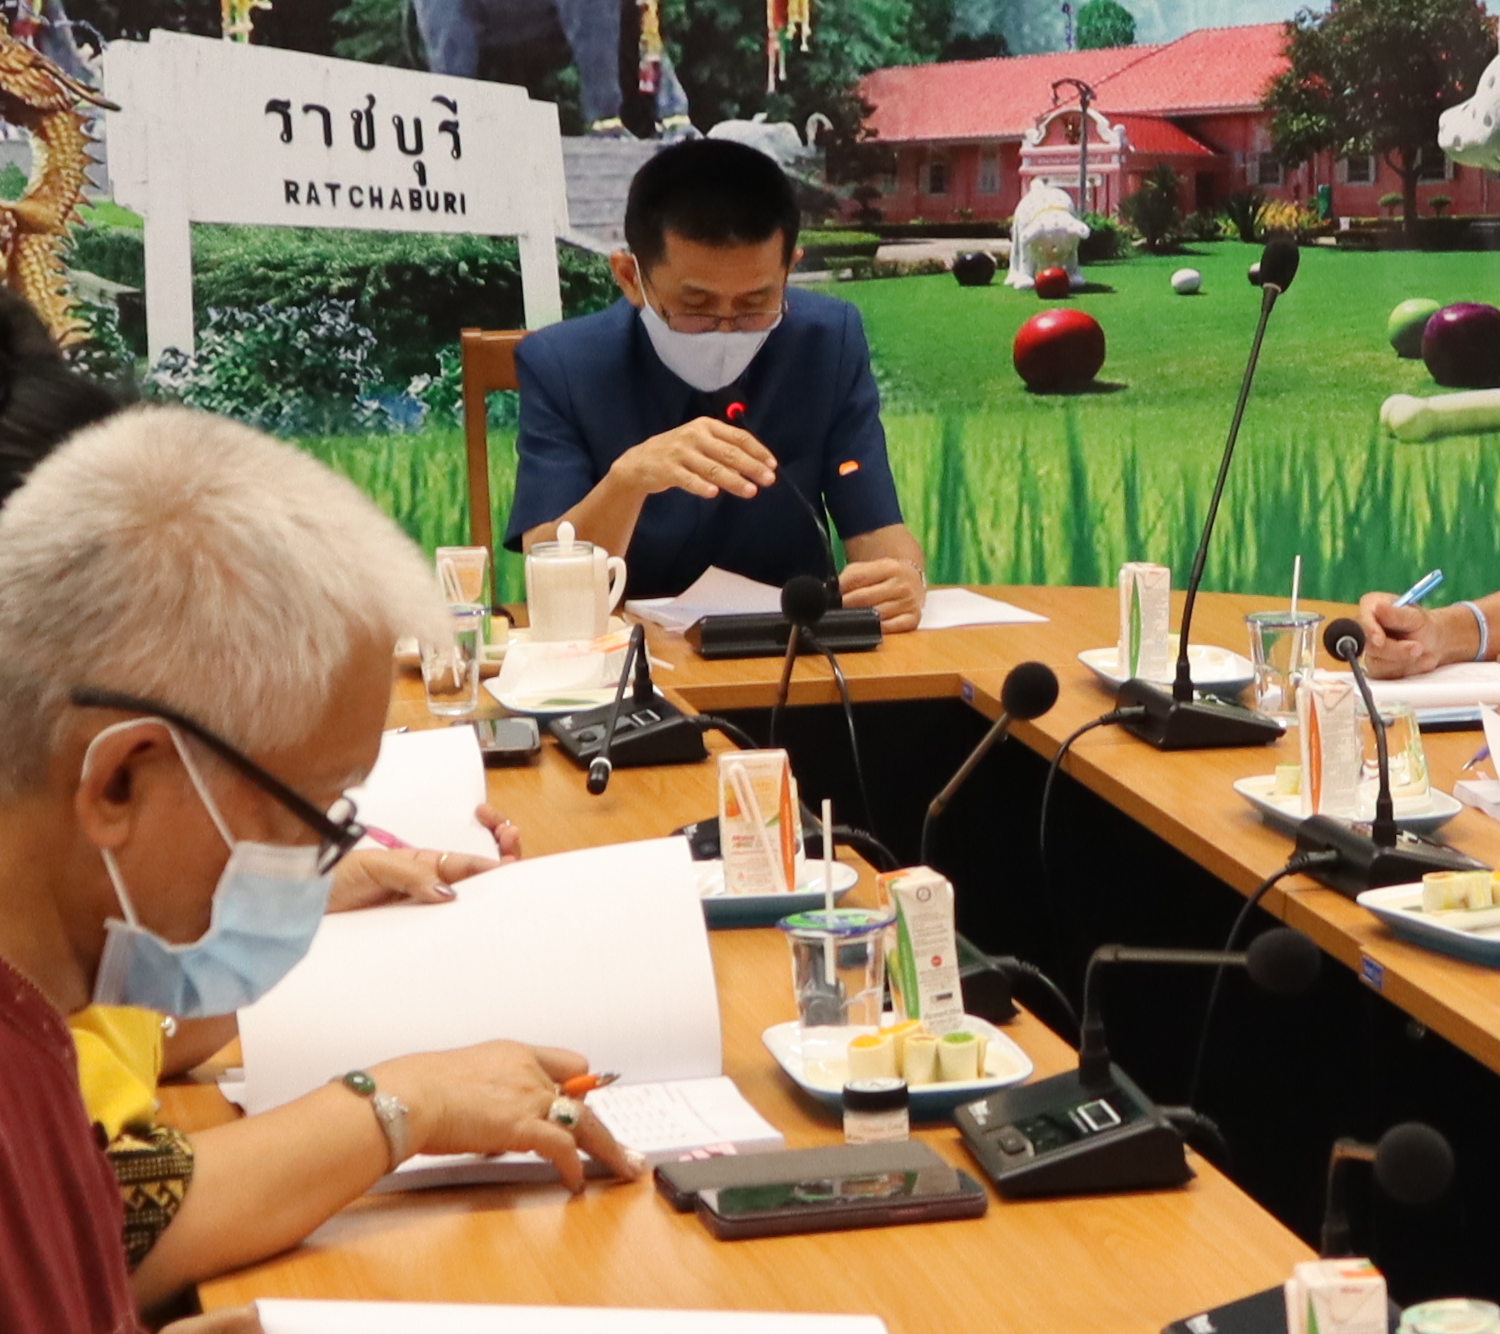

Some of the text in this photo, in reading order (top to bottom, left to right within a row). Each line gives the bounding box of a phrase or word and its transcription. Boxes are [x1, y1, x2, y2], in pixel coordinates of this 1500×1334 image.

[264, 93, 463, 187] ราชบุรี
[283, 179, 467, 215] RATCHABURI
